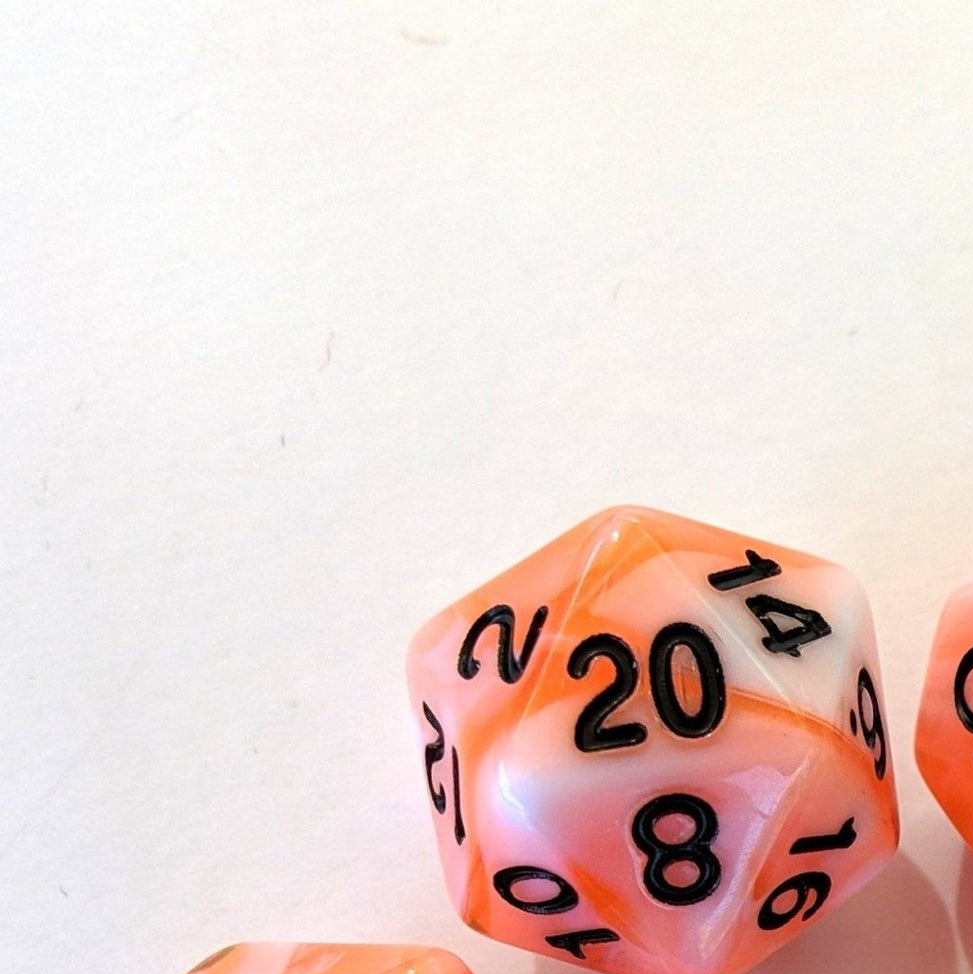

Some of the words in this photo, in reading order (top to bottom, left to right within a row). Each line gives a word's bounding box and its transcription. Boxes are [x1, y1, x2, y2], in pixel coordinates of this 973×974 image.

[456, 603, 549, 685] 2
[706, 548, 833, 659] 14
[566, 620, 728, 754] 20
[629, 791, 723, 908] 8
[756, 815, 858, 932] 16
[492, 864, 621, 961] 10
